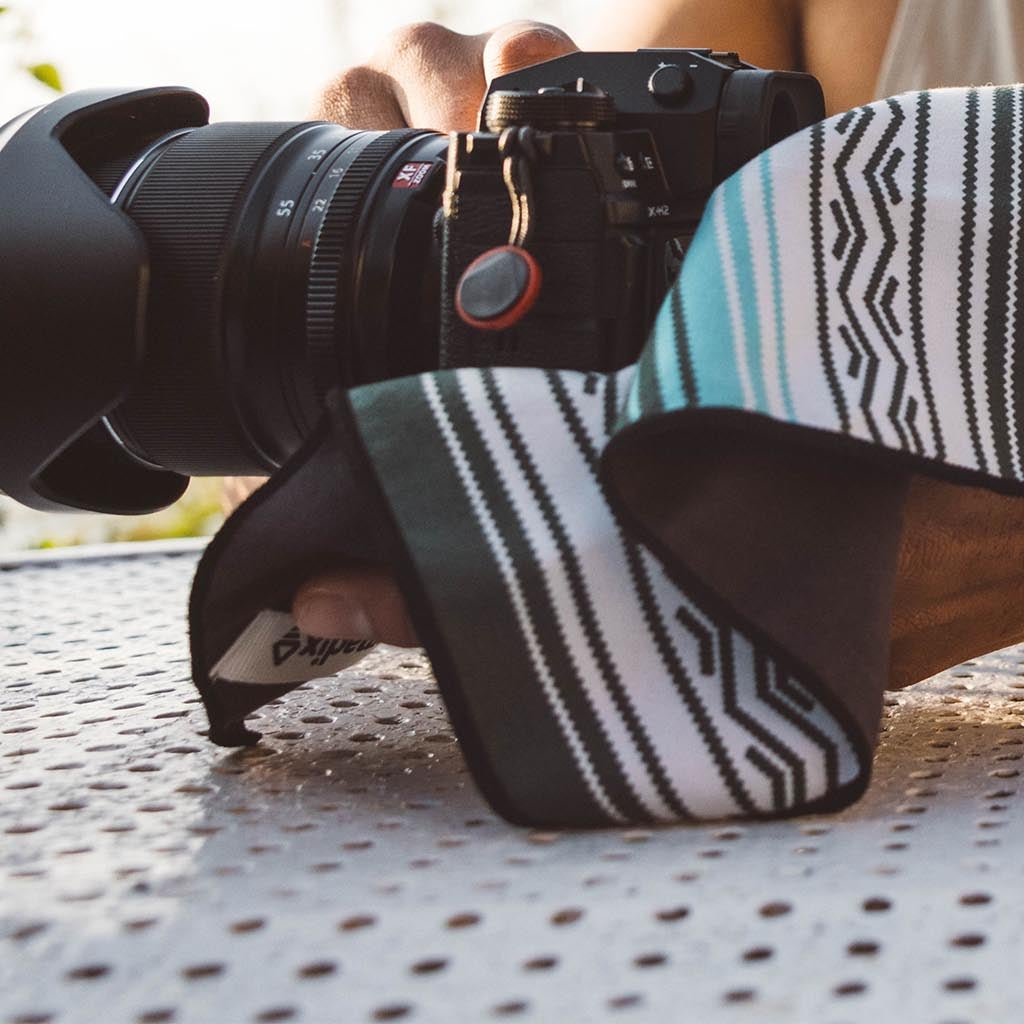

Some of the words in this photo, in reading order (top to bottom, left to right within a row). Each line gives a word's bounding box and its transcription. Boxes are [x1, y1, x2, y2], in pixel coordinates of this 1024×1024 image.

[276, 199, 295, 217] 55
[307, 149, 327, 161] 35
[312, 198, 327, 213] 22
[328, 167, 344, 178] 16
[396, 164, 418, 183] XF
[412, 163, 433, 185] ZOOM
